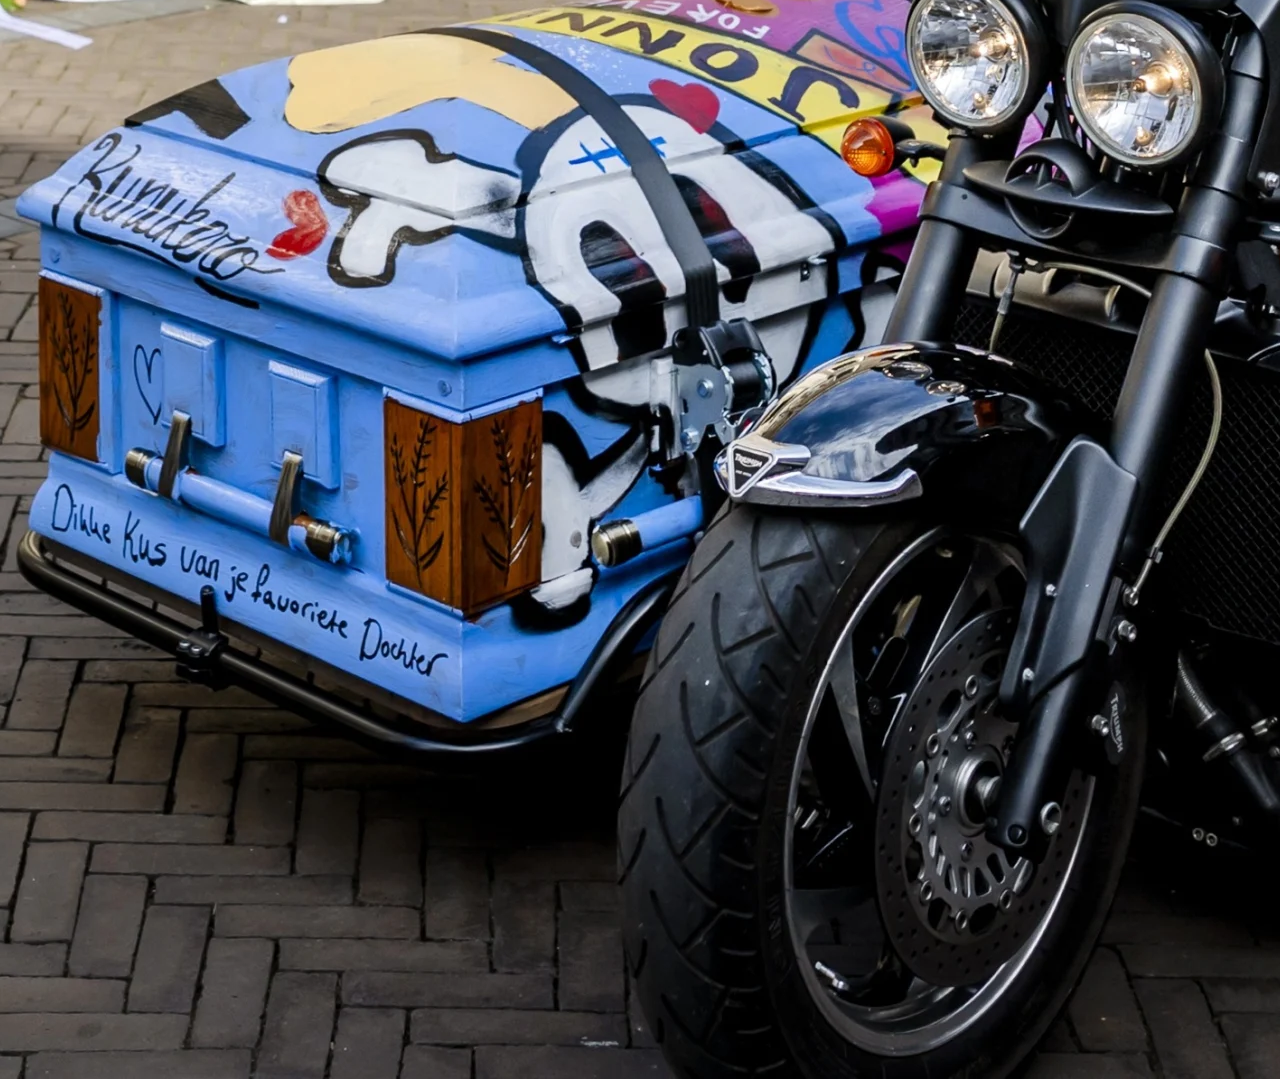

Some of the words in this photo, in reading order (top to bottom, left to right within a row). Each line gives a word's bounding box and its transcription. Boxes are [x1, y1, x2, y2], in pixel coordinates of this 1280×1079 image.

[123, 510, 168, 568] Kus
[180, 545, 220, 582] van
[224, 565, 247, 602] je
[359, 618, 450, 678] Dochter
